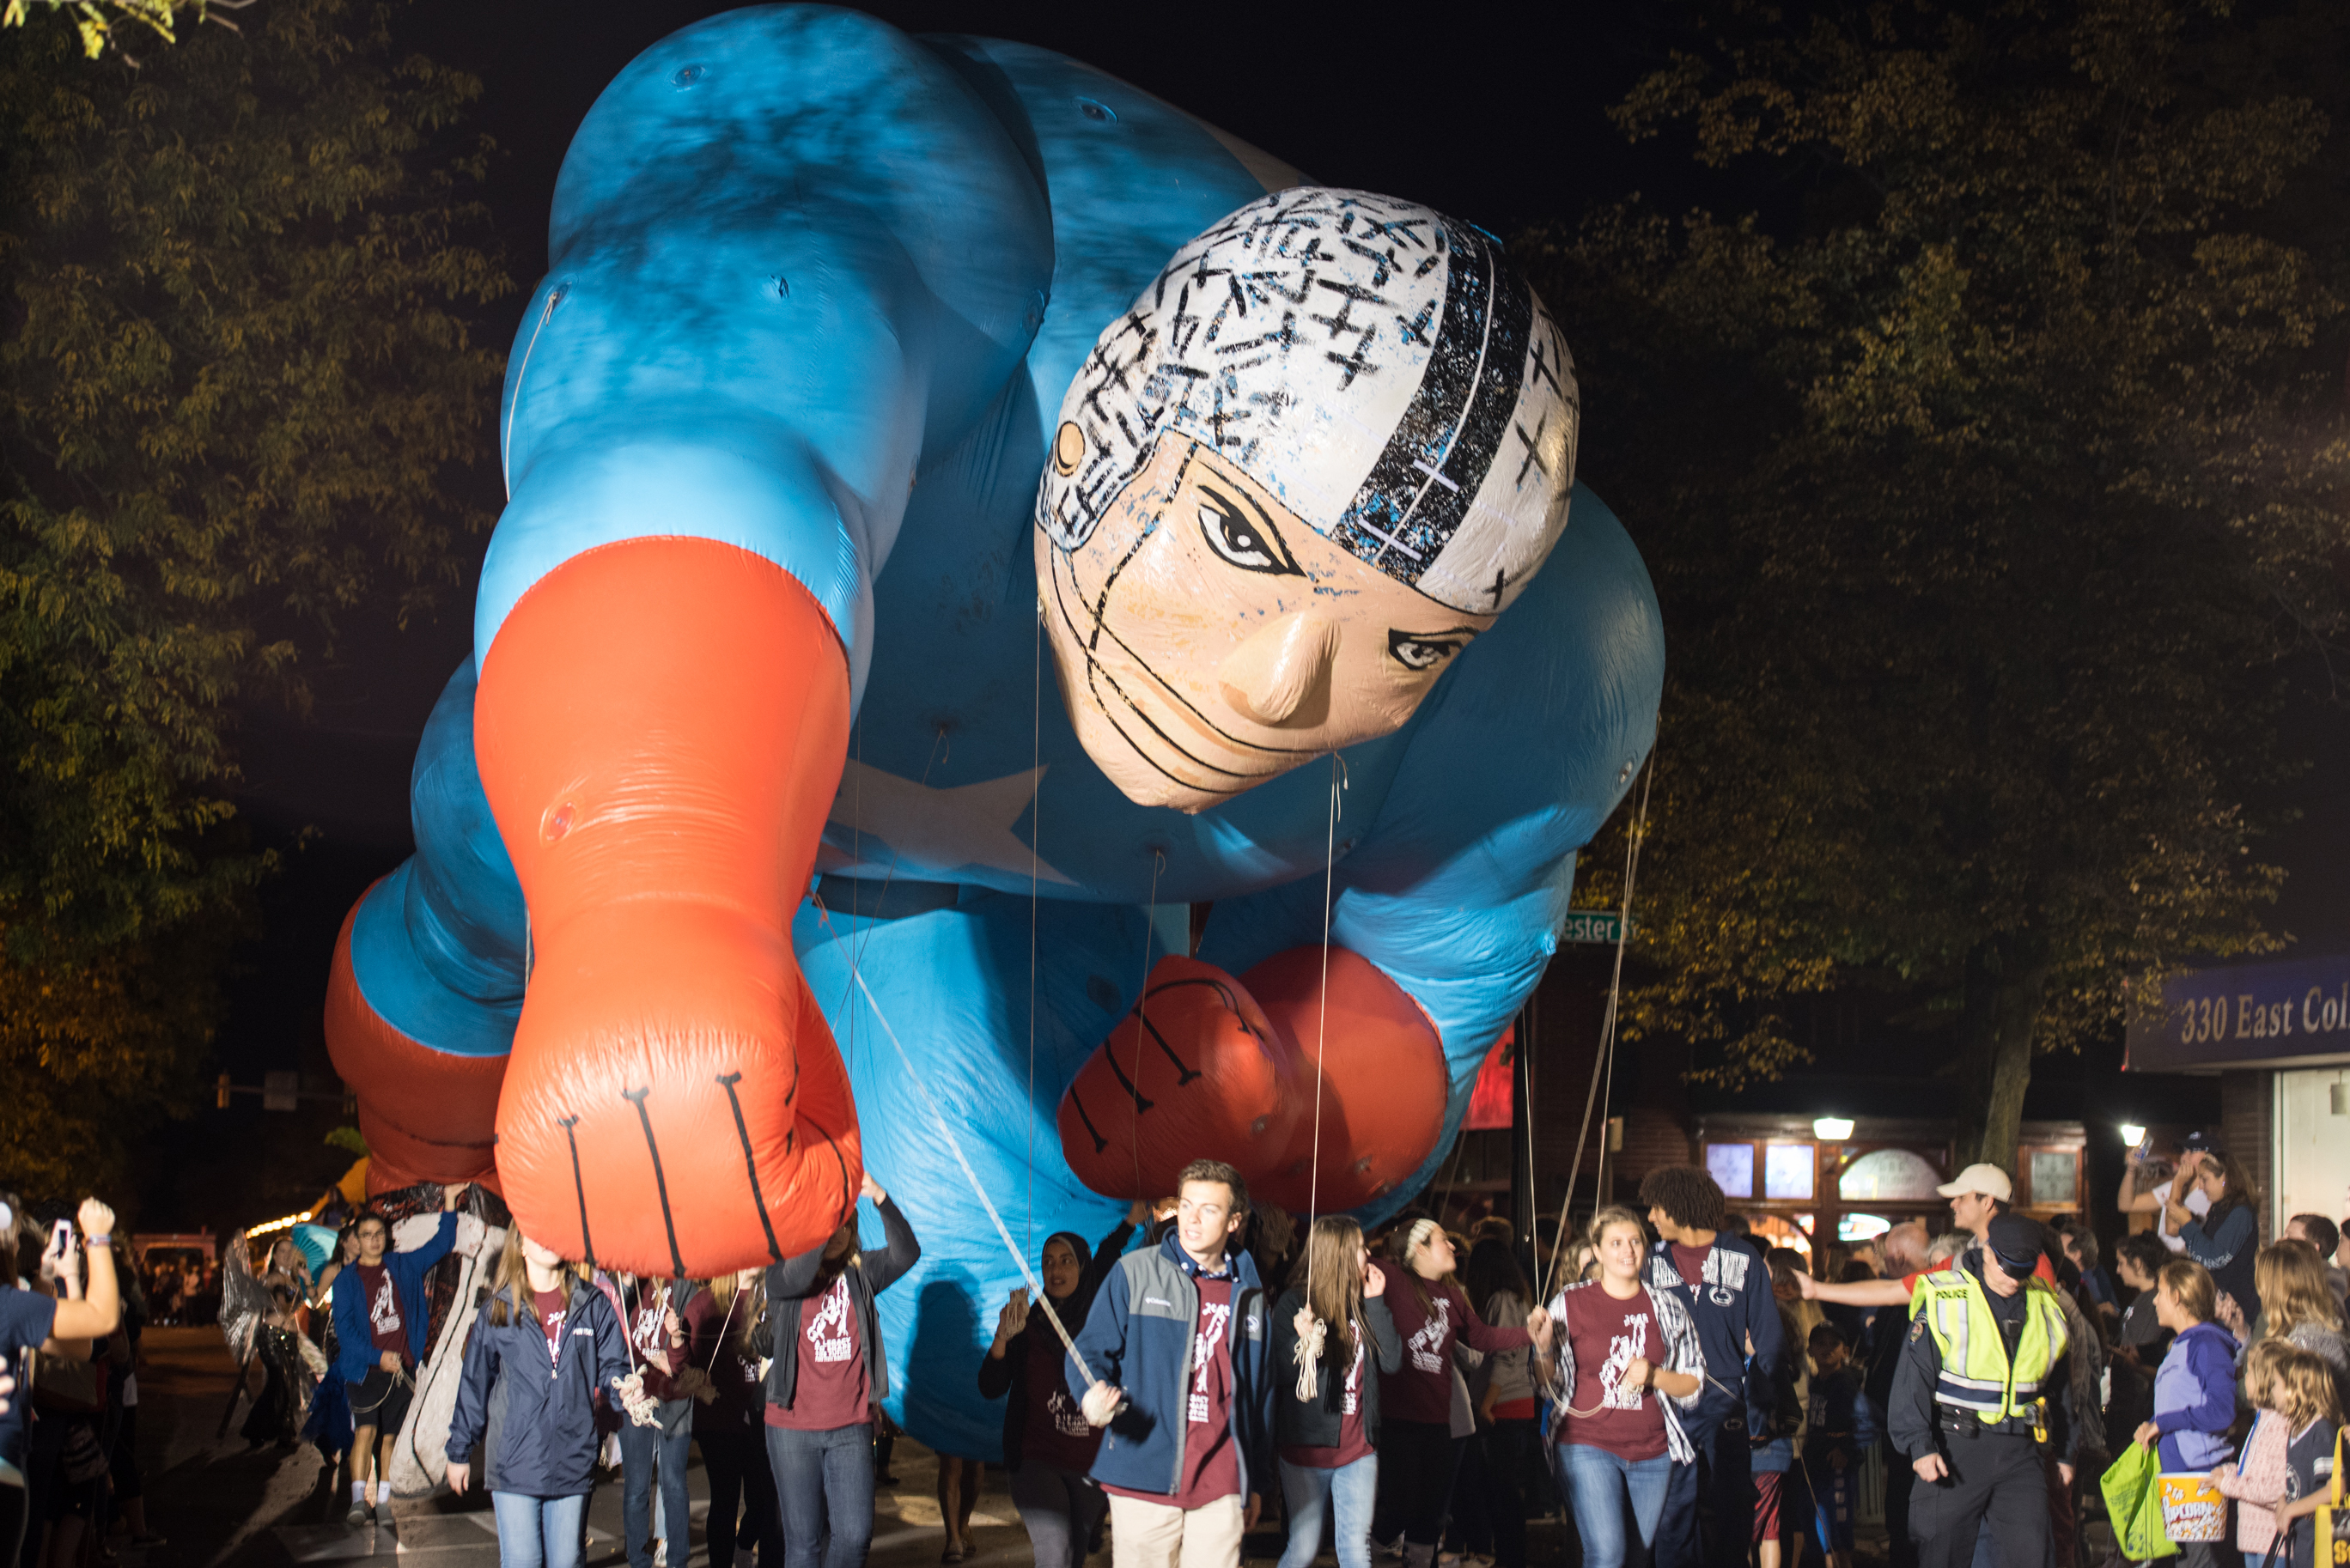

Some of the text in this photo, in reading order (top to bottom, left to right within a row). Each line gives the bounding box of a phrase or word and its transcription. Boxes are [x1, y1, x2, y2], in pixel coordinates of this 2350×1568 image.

[1563, 915, 1615, 941] ester
[2182, 981, 2350, 1044] 330 East Col
[1936, 1289, 1969, 1299] POLICE
